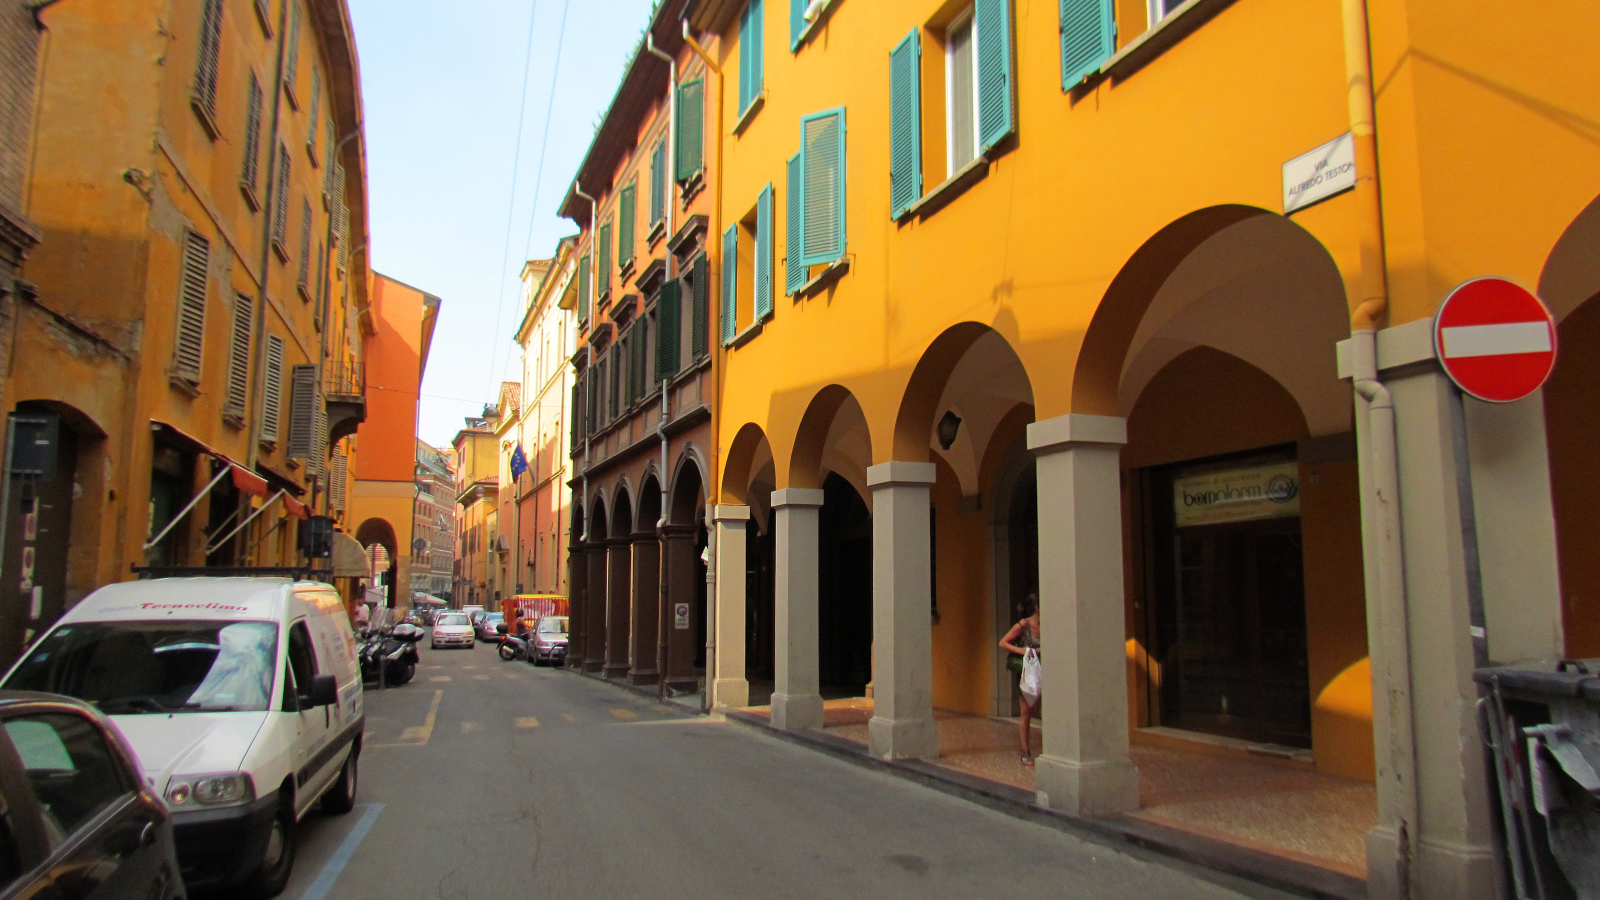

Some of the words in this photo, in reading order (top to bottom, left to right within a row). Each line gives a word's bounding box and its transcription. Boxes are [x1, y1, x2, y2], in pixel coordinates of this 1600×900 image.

[1314, 158, 1328, 172] VIA
[1288, 175, 1323, 197] ALFREDO
[140, 602, 248, 611] Tecnoclima
